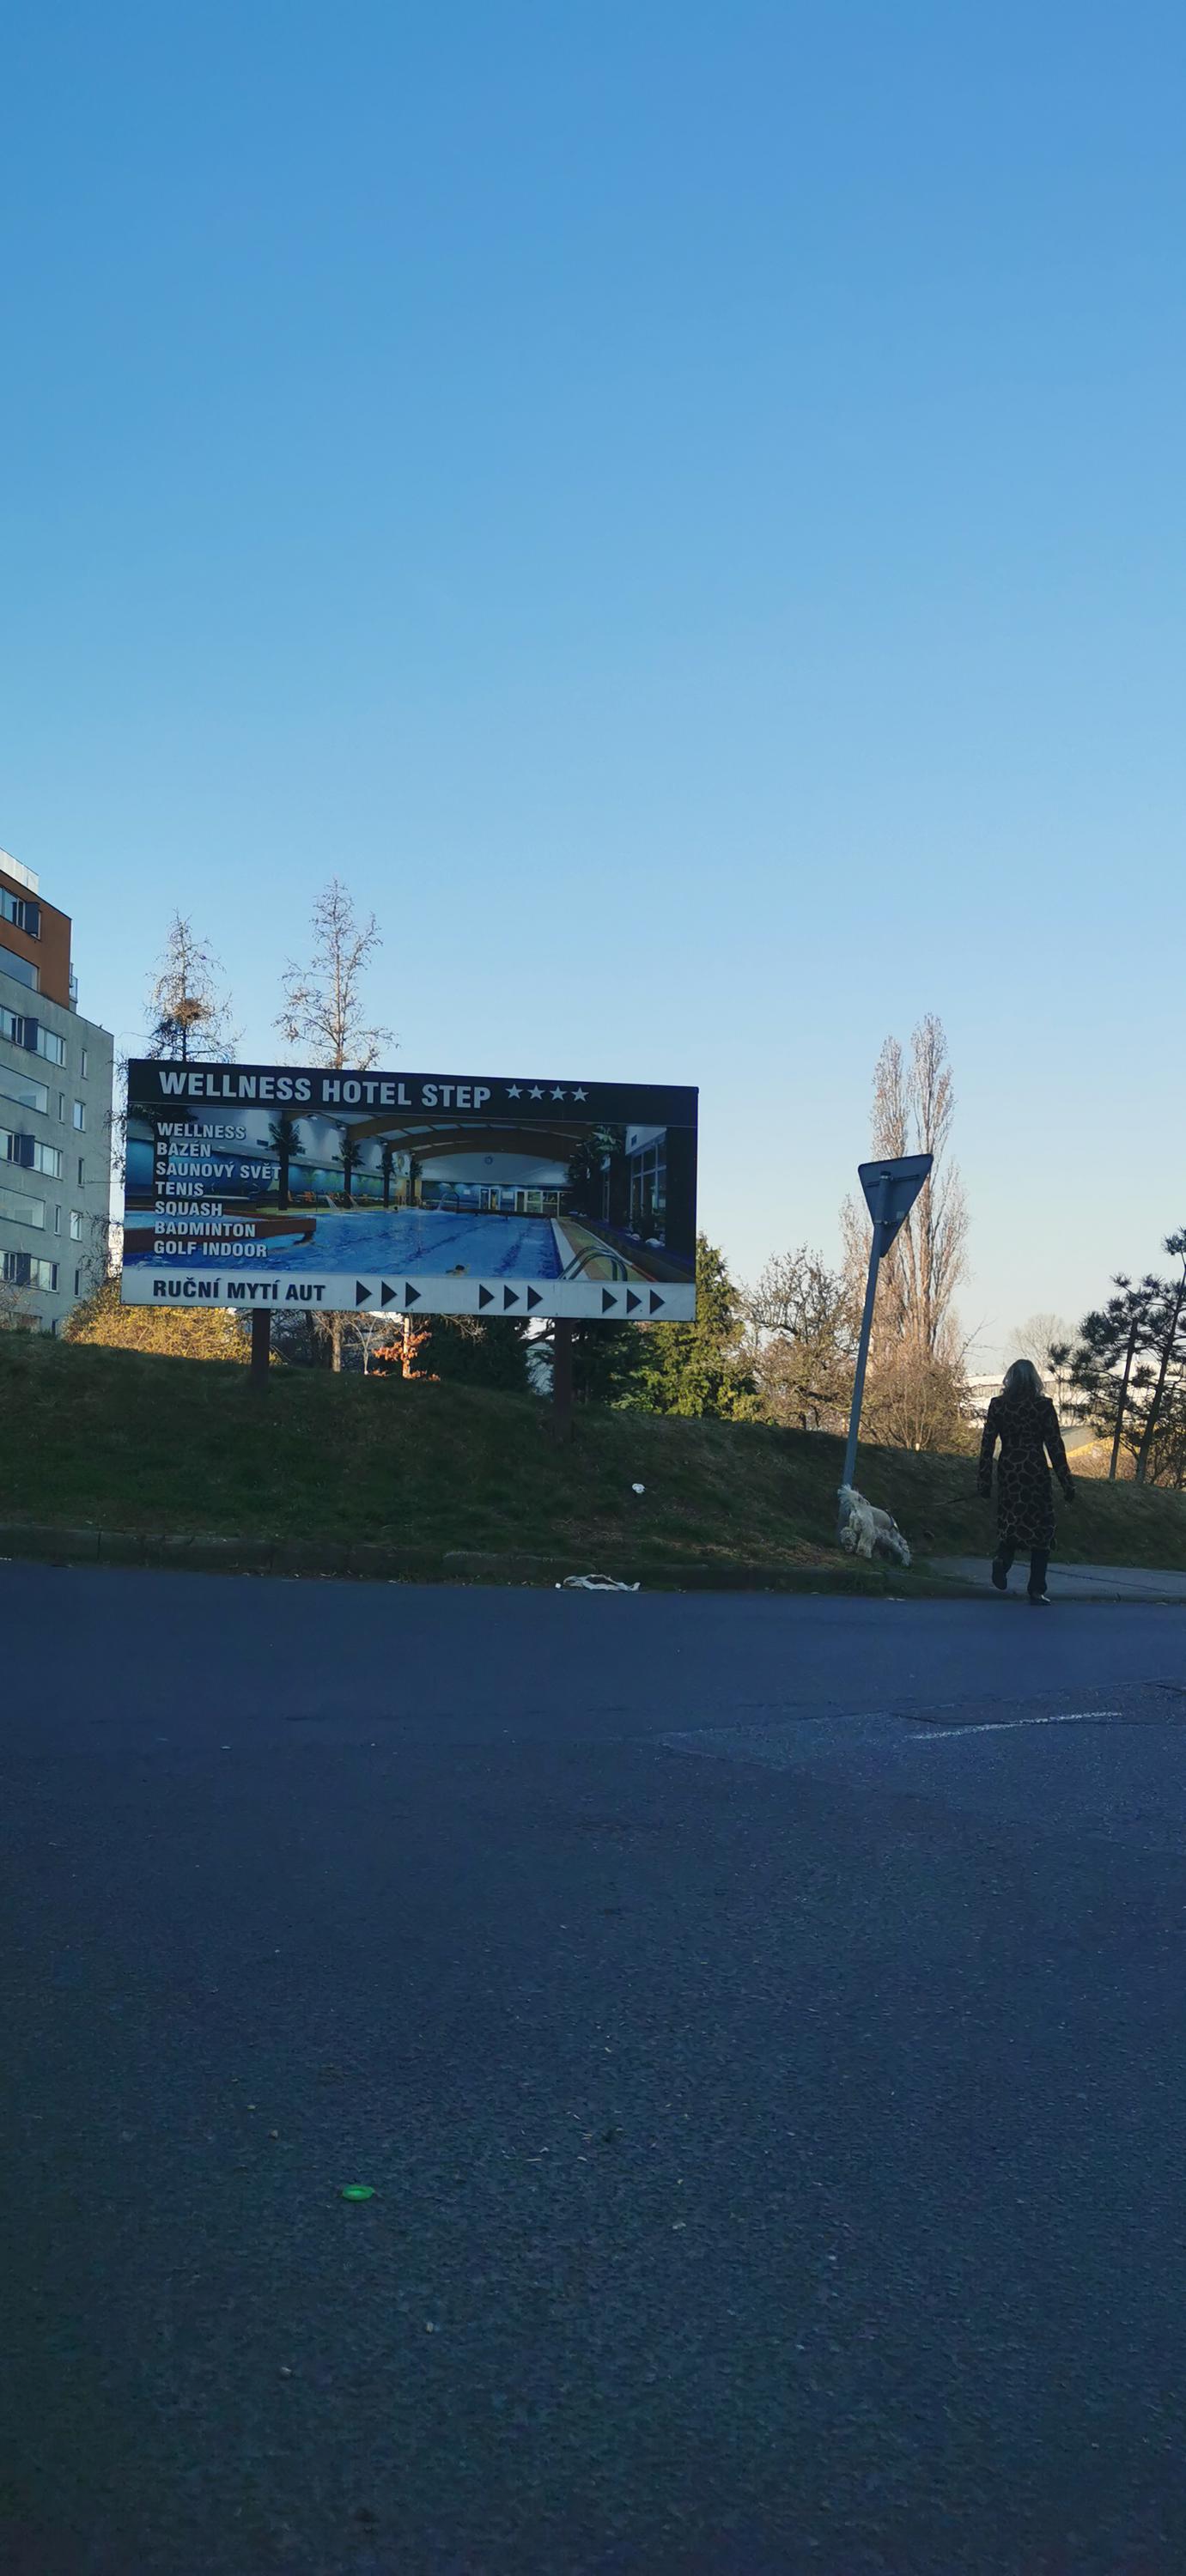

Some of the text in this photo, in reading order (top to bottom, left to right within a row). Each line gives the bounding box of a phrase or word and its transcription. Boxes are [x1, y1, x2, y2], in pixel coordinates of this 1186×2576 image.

[159, 1071, 492, 1109] WELLNESS HOTEL STEP
[156, 1121, 246, 1140] WELLNESS
[156, 1139, 211, 1158] BAZÉN
[155, 1161, 283, 1181] SAUNOVÝ SVĚT
[155, 1181, 204, 1197] TENIS
[154, 1200, 223, 1218] SQUASH
[154, 1220, 257, 1238] BADMINTON
[154, 1240, 268, 1258] GOLF INDOOR
[153, 1276, 326, 1302] RUČNÍ MYTÍ AUT
